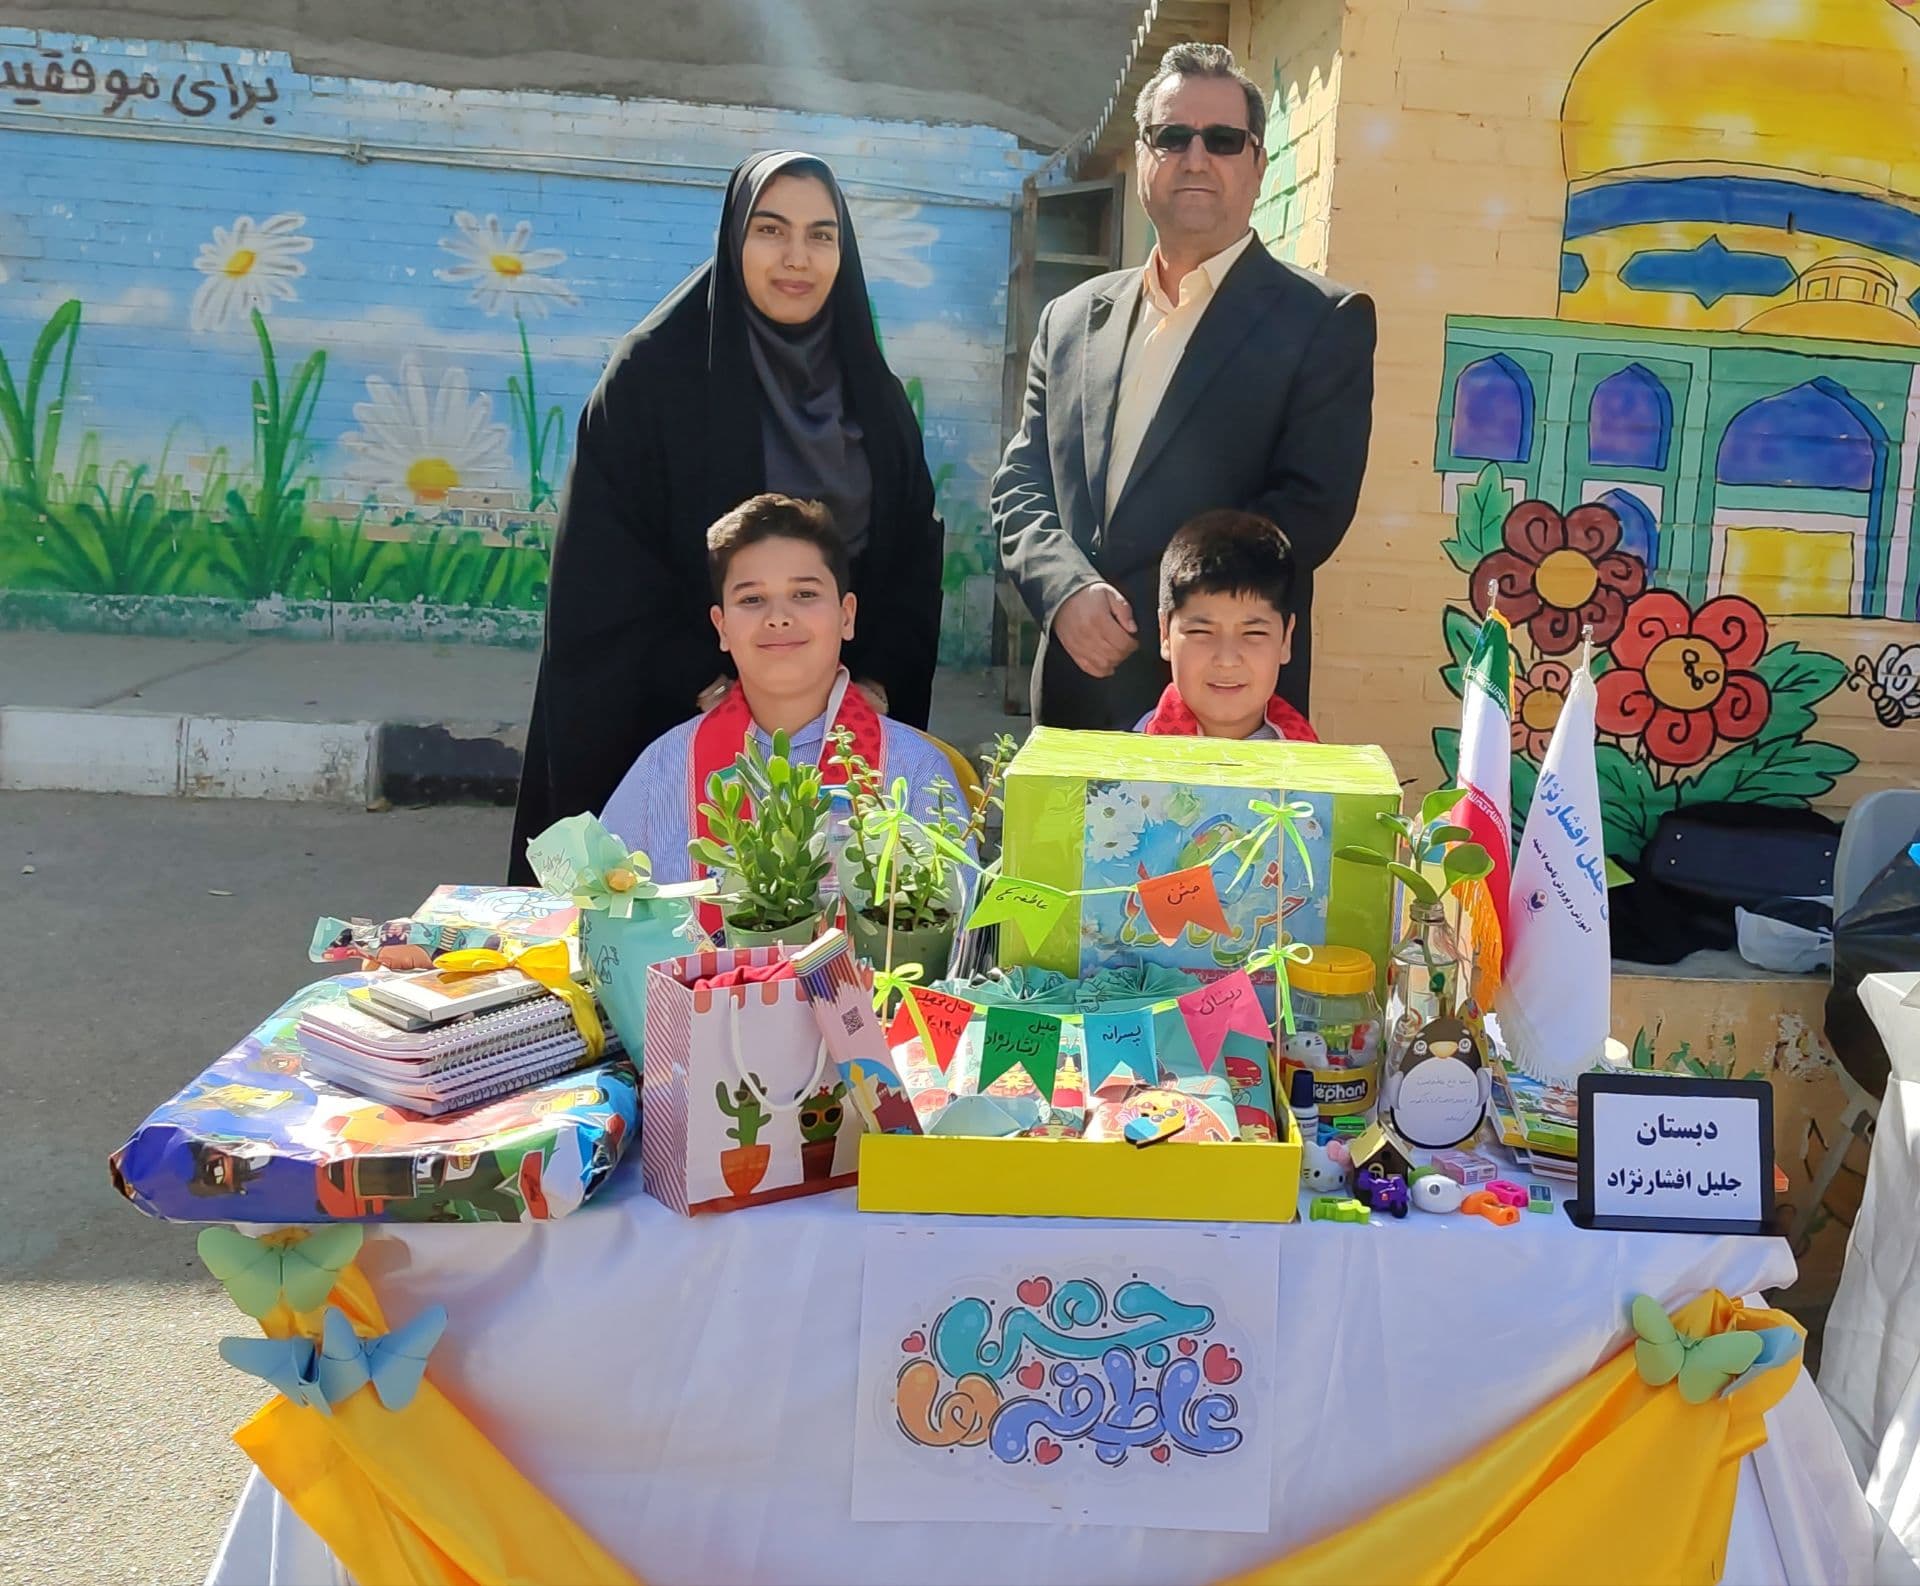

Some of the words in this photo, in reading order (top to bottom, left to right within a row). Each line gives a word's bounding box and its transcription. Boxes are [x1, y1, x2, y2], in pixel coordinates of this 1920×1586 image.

[172, 62, 279, 125] برای
[1576, 853, 1604, 896] جلیل
[1014, 893, 1048, 910] عاطفه
[1168, 883, 1200, 905] جشن
[1552, 879, 1571, 904] پرورش
[1570, 907, 1592, 934] آموزش
[915, 992, 947, 1007] تحصیل
[1028, 1020, 1057, 1036] جلیل
[1102, 1025, 1142, 1046] پسرانه
[1313, 1082, 1366, 1102] lephant
[1636, 1113, 1718, 1147] دبستان
[1607, 1167, 1692, 1195] افشارنژاد
[1697, 1170, 1742, 1197] جلیل
